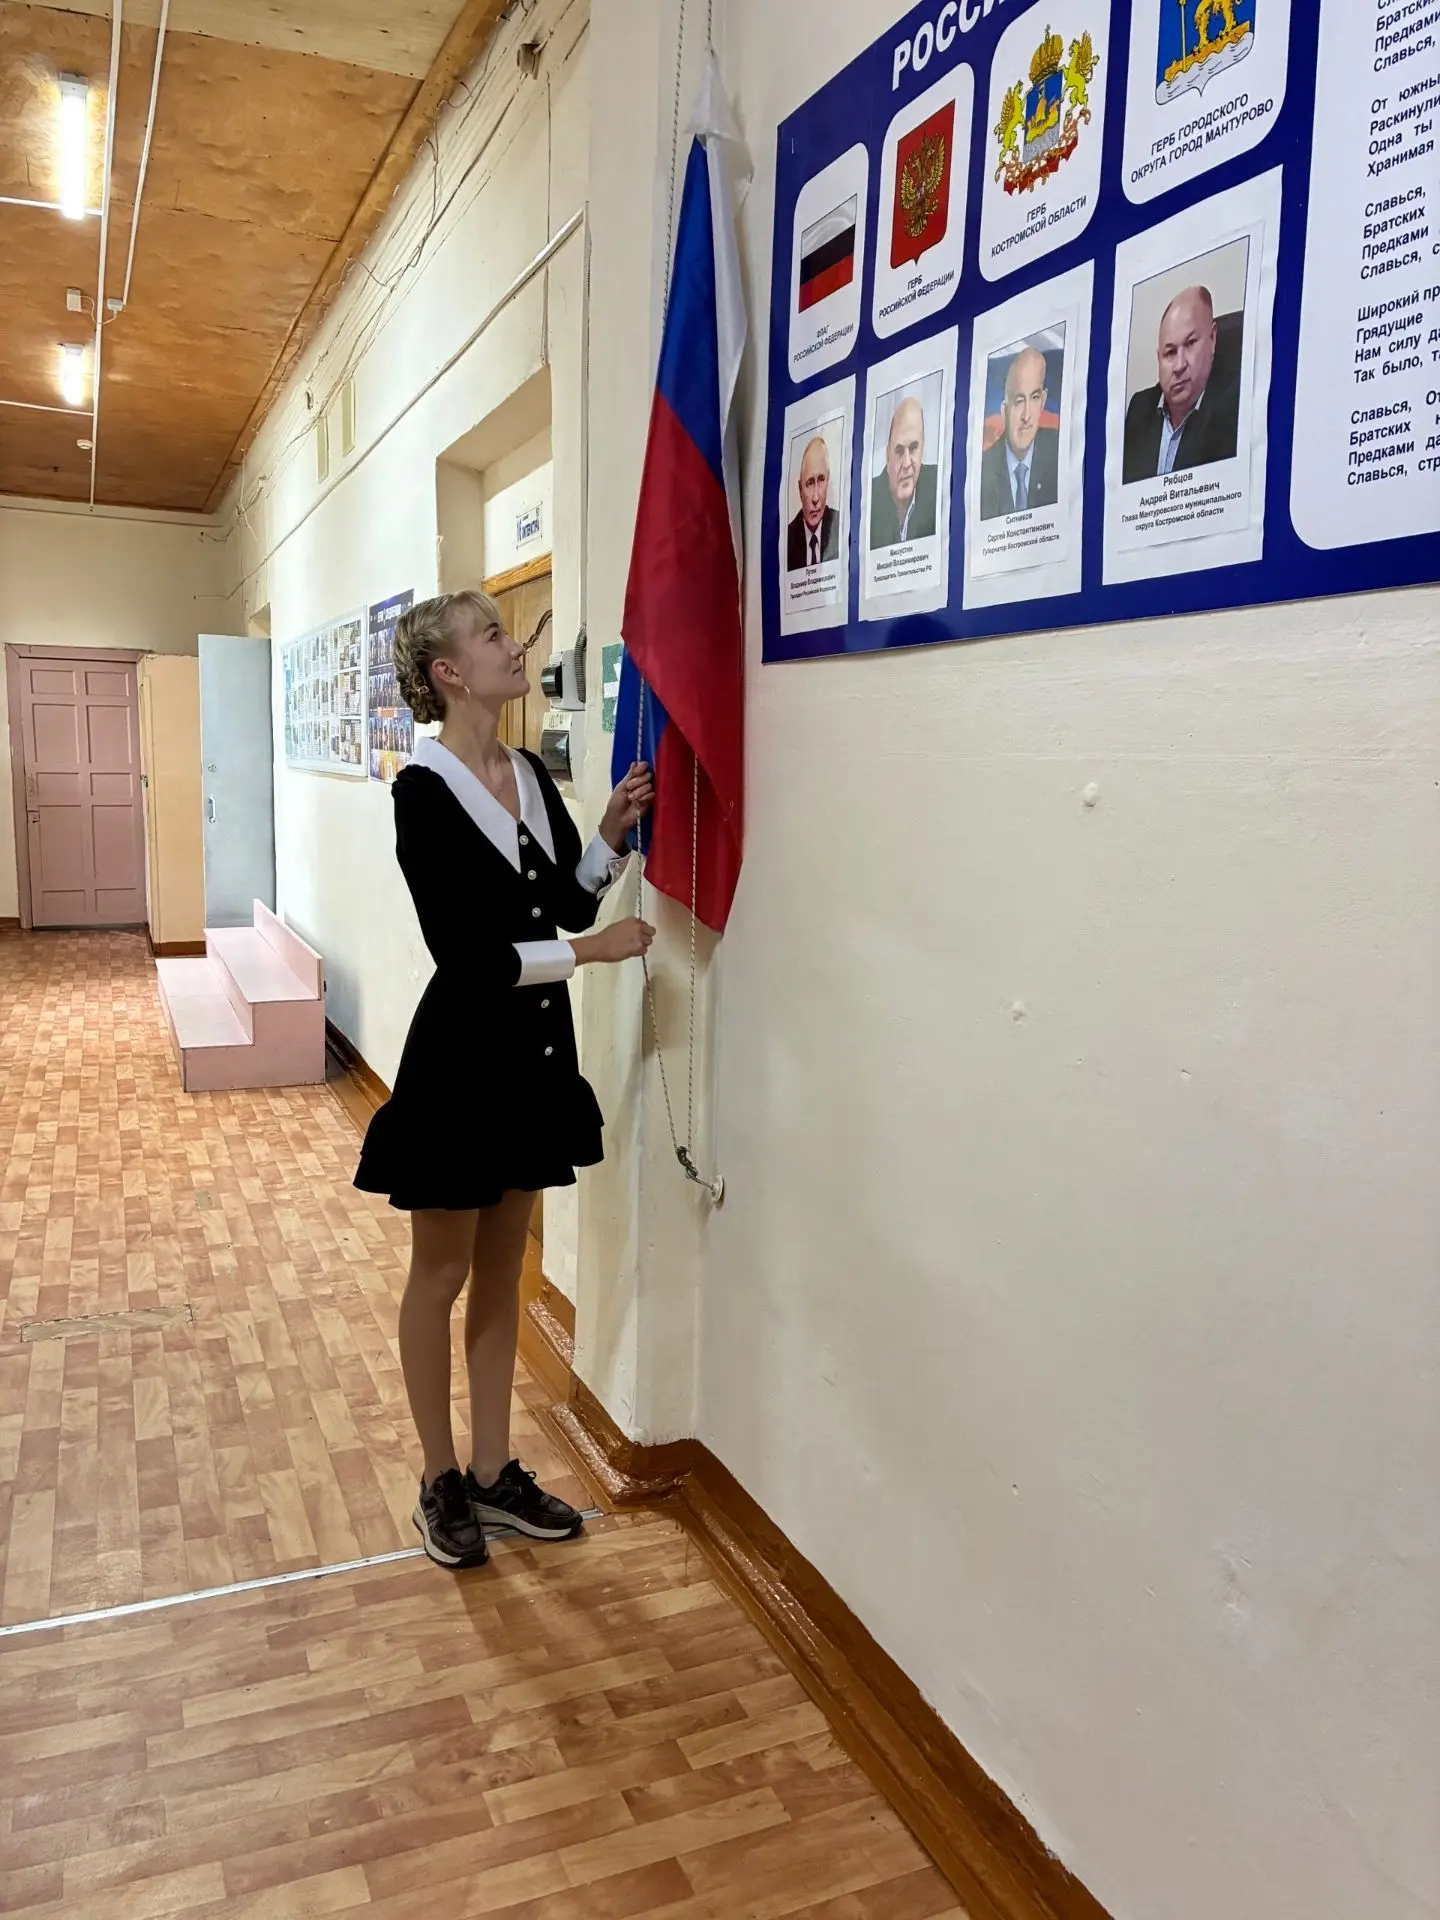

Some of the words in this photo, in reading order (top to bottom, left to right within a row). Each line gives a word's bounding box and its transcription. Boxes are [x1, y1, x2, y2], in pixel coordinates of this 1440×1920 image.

[1373, 35, 1436, 72] Славься,
[1371, 97, 1388, 114] От
[1150, 132, 1176, 156] ГЕРБ
[1178, 93, 1249, 141] ГОРОДСКОГО
[1368, 132, 1403, 156] Одна
[1414, 119, 1433, 136] ты
[1130, 155, 1167, 183] ОКРУГА
[1169, 134, 1203, 163] ГОРОД
[1205, 98, 1274, 145] МАНТУРОВО
[1366, 139, 1434, 178] Хранимая
[1026, 202, 1047, 223] ГЕРБ
[1365, 186, 1426, 217] Славься,
[991, 216, 1047, 258] КОСТРОМСКОЙ
[1048, 195, 1087, 226] ОБЛАСТИ
[1363, 206, 1425, 240] Братских
[1361, 225, 1429, 260] Предками
[1360, 250, 1422, 280] Славься,
[879, 289, 917, 320] РОССИЙСКОЙ
[917, 269, 955, 297] ФЕДЕРАЦИИ
[907, 274, 923, 291] ГЕРБ
[1358, 289, 1419, 322] Широкий
[1356, 312, 1423, 345] Грядущие
[1354, 345, 1381, 364] Нам
[1388, 333, 1422, 354] силу
[1354, 368, 1376, 384] Так
[1382, 355, 1424, 376] было,
[1350, 400, 1412, 425] Славься,
[1349, 420, 1412, 447] Братских
[1348, 440, 1415, 467] Предками
[1163, 472, 1194, 487] Рябцов
[1347, 464, 1408, 486] Славься,
[1121, 513, 1139, 523] Глава
[1139, 503, 1184, 520] Мантуровского
[1184, 490, 1242, 510] муниципального
[1139, 492, 1168, 507] Андрей
[1169, 481, 1220, 501] Витальевич
[1135, 521, 1154, 532] округа
[1155, 512, 1195, 527] Костромской
[1196, 506, 1225, 519] области
